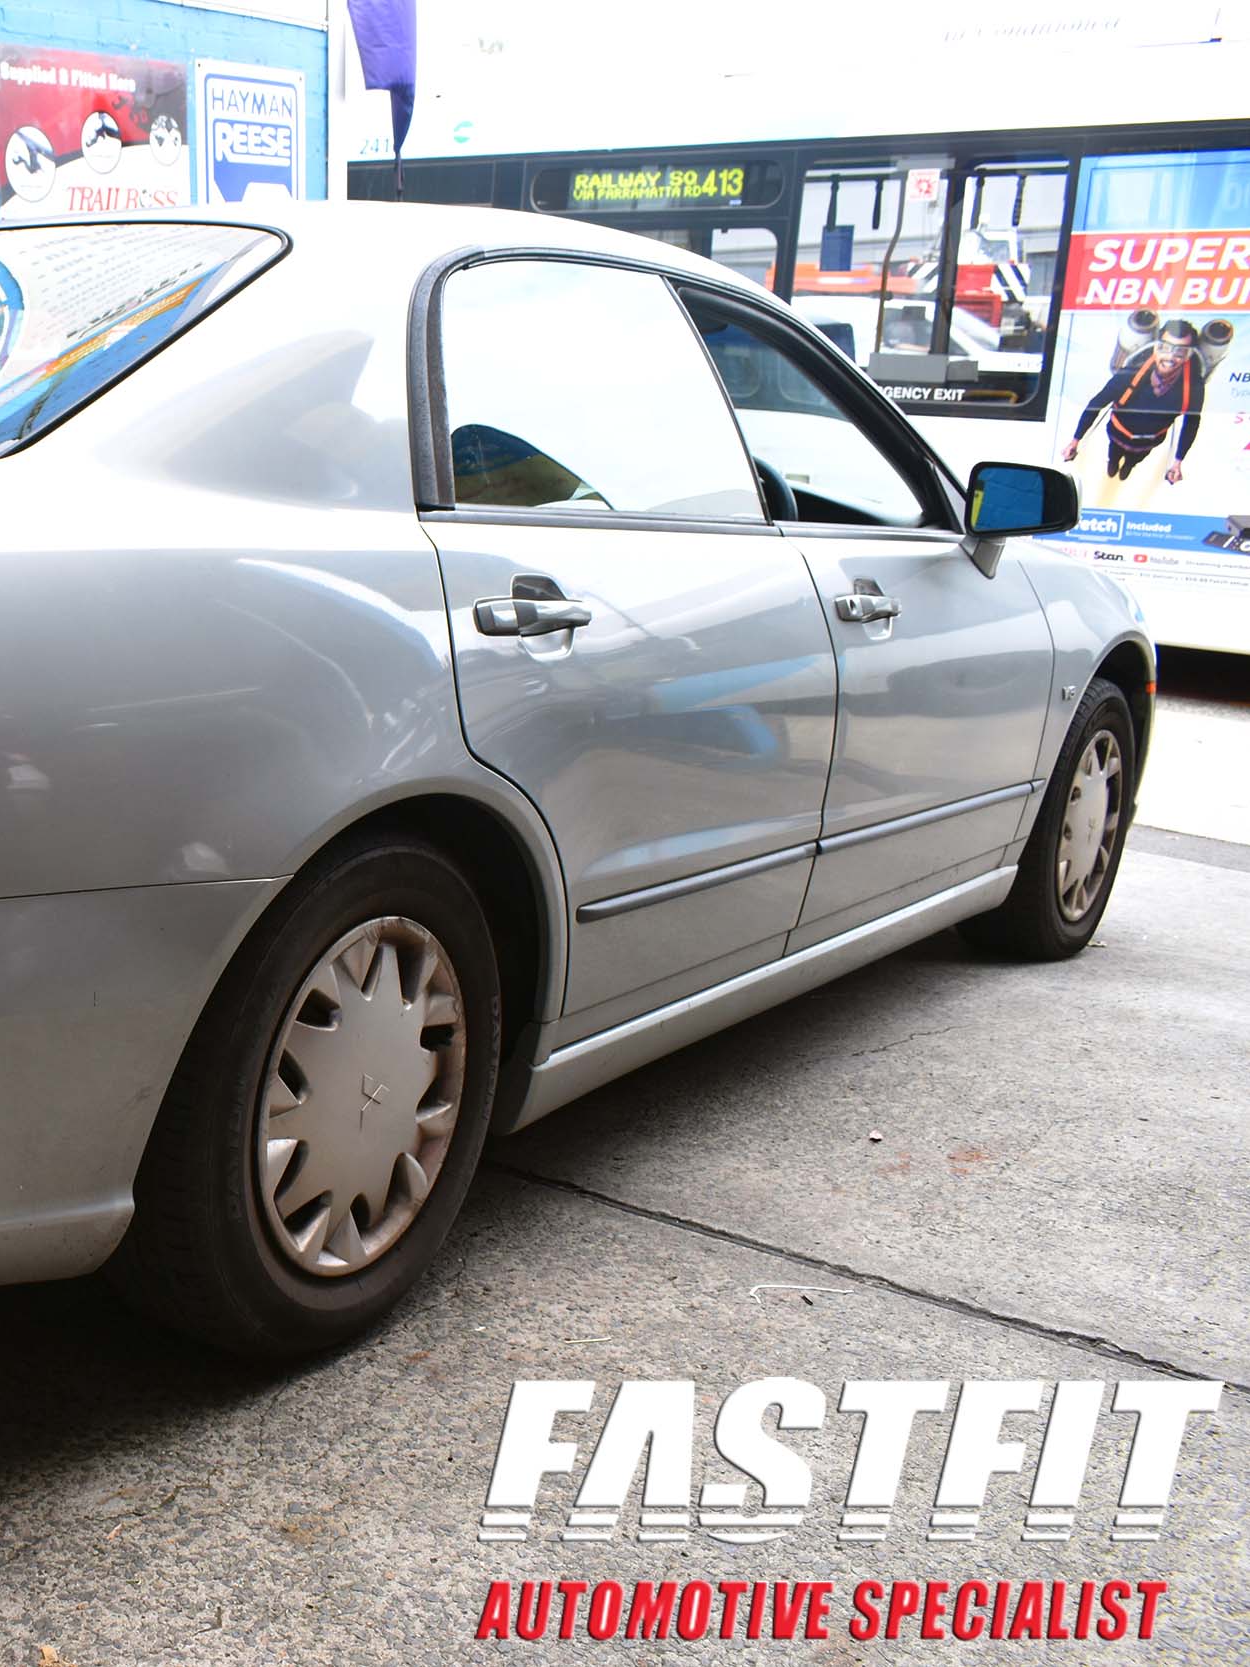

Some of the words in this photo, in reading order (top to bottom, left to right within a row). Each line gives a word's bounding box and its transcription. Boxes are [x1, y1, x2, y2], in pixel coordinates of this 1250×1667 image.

[0, 61, 56, 86] Supplied
[71, 69, 106, 89] Fitted
[108, 73, 136, 92] Here
[212, 87, 292, 118] HAYMAN
[215, 121, 291, 165] REESE
[575, 172, 661, 189] RAILWAY
[701, 167, 744, 197] 413
[1088, 237, 1250, 272] SUPER
[1083, 277, 1176, 305] NBN
[933, 387, 966, 401] EXIT
